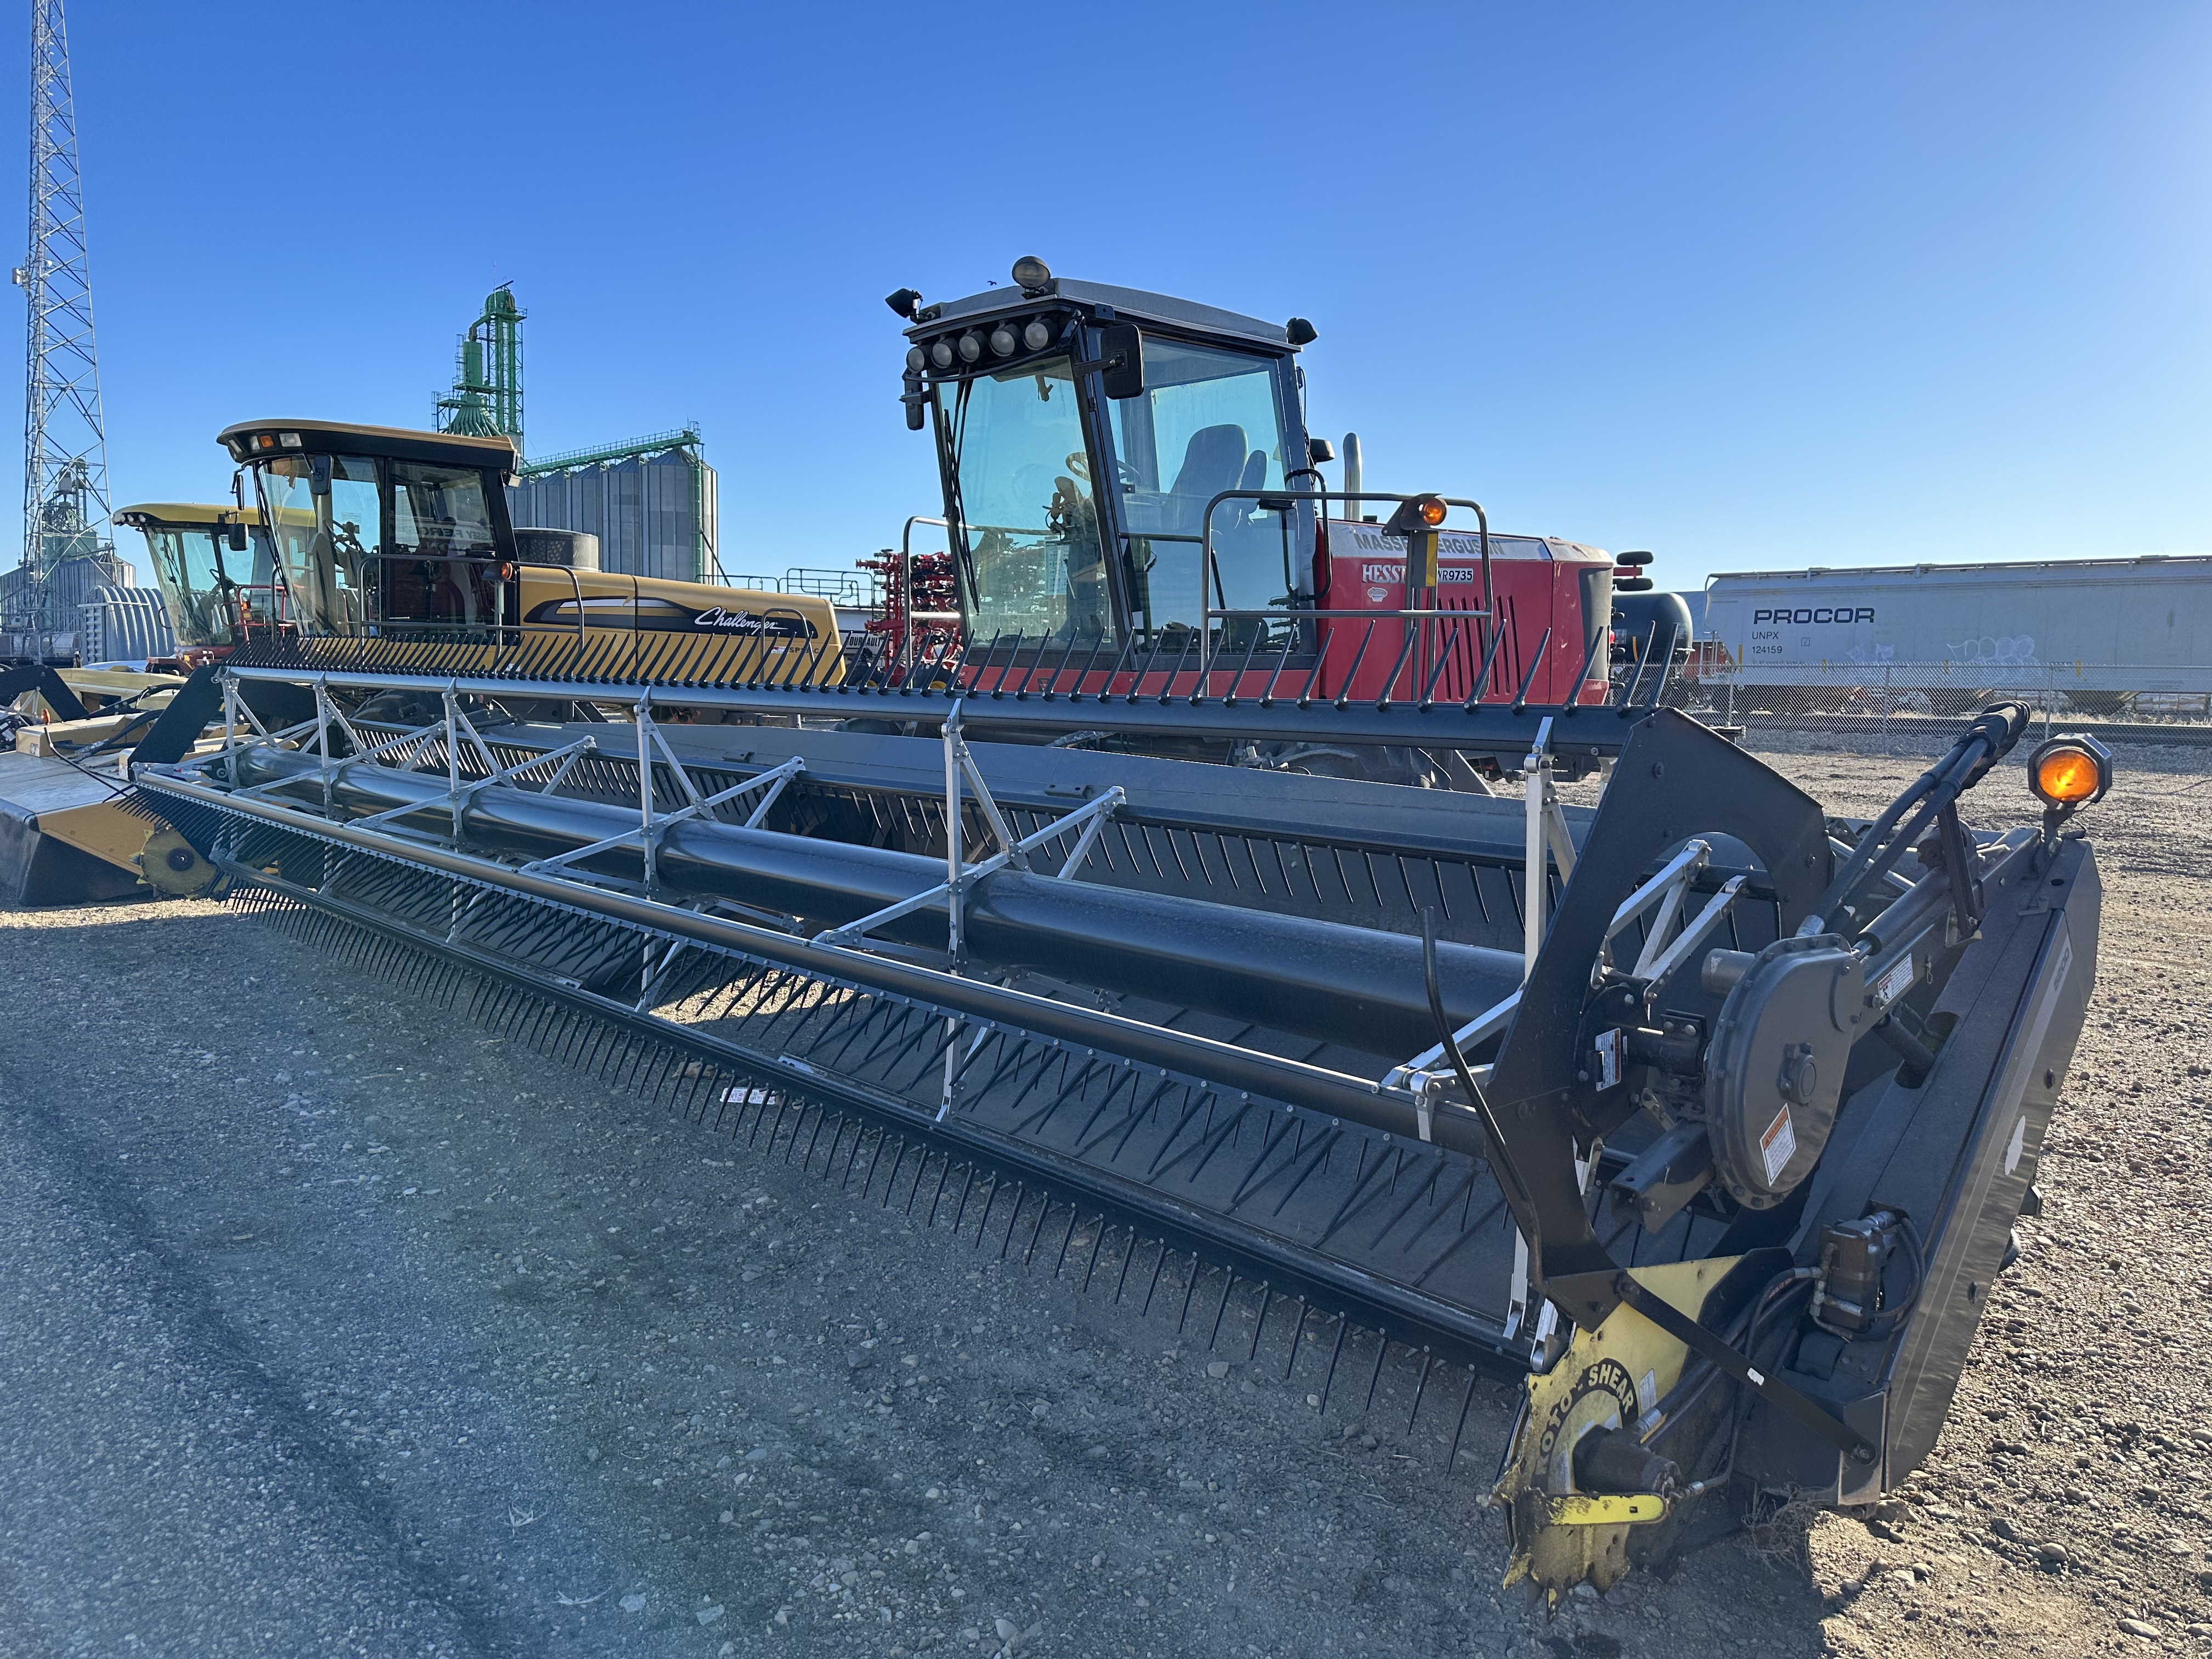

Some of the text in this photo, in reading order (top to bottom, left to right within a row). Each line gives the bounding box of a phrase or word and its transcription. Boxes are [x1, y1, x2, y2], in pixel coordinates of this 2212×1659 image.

[1353, 534, 1408, 552] MASSE
[695, 606, 788, 635] Challenger
[1753, 608, 1875, 624] PROCOR
[1752, 631, 1779, 640] UNPX
[1752, 646, 1782, 654] 124159
